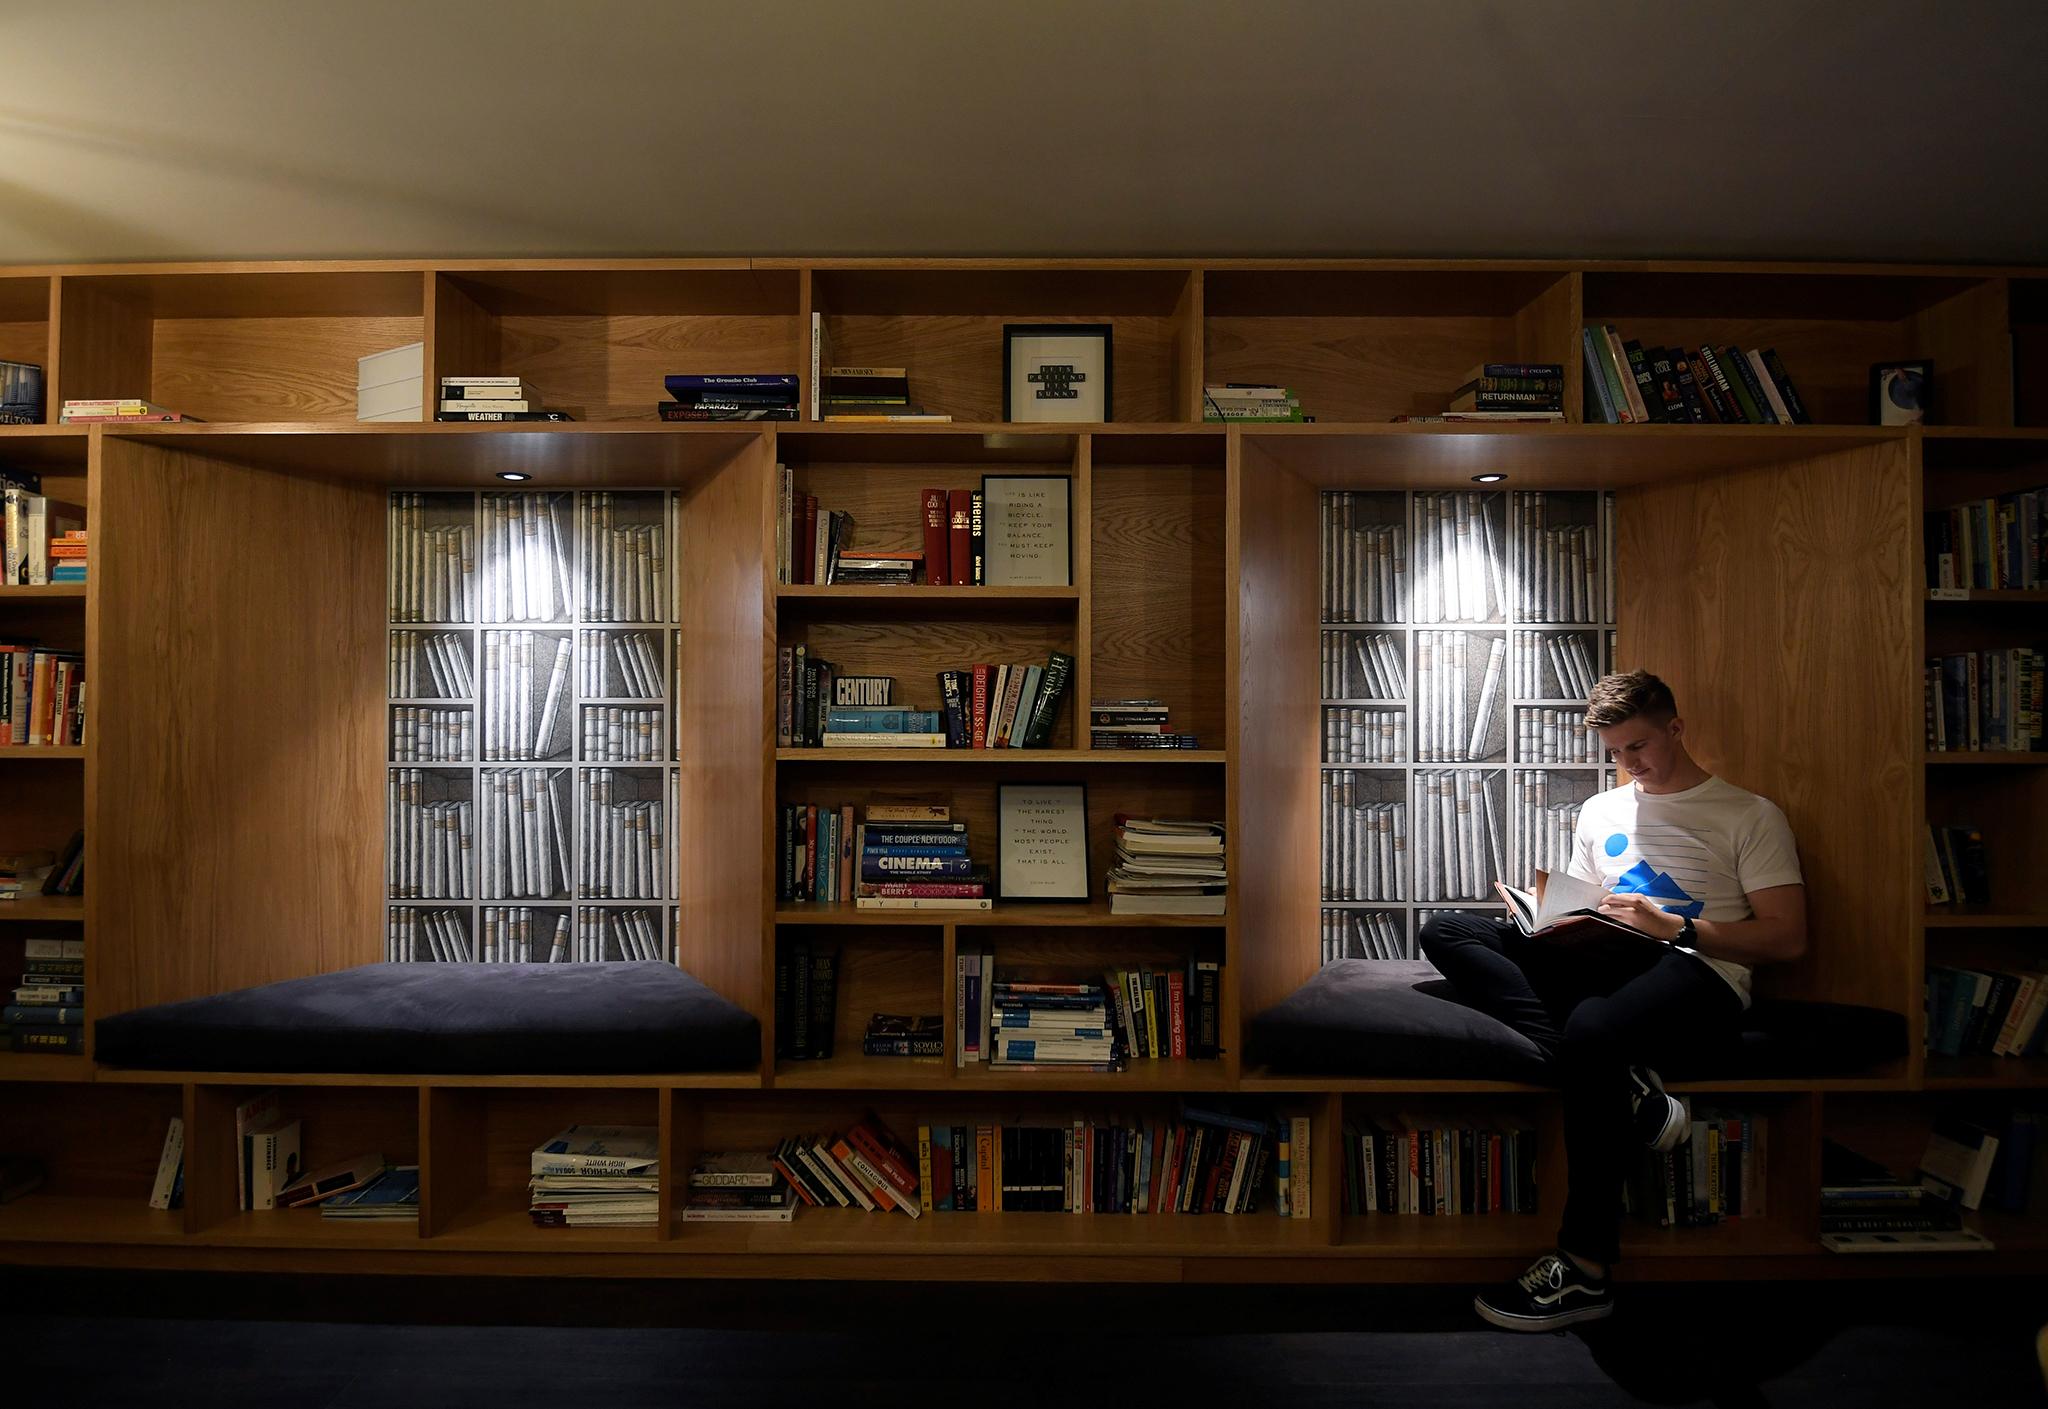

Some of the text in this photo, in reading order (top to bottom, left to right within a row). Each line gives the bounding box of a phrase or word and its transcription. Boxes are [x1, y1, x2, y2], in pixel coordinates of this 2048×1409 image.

[1702, 349, 1730, 391] BILLINGHAM
[1482, 393, 1536, 401] RETURN MAN
[467, 412, 503, 421] WEATHER
[973, 501, 982, 537] Reichs
[2020, 654, 2032, 678] ANDY
[836, 678, 891, 706] CENTURY
[975, 674, 985, 716] DEIGHTON
[974, 717, 985, 742] SS-GB
[881, 834, 957, 844] THE COUPLE NEXT DOOR
[878, 857, 943, 870] CINEMA
[912, 888, 958, 896] COOKBOOK
[979, 1138, 990, 1170] Capital
[584, 1159, 627, 1168] HIGH WHITE
[581, 1167, 625, 1175] SUPERIOR
[856, 1159, 889, 1191] CONTAGIOUS
[702, 1174, 749, 1186] GODDARD
[1838, 1219, 1933, 1230] THE GREAT MIGRATION
